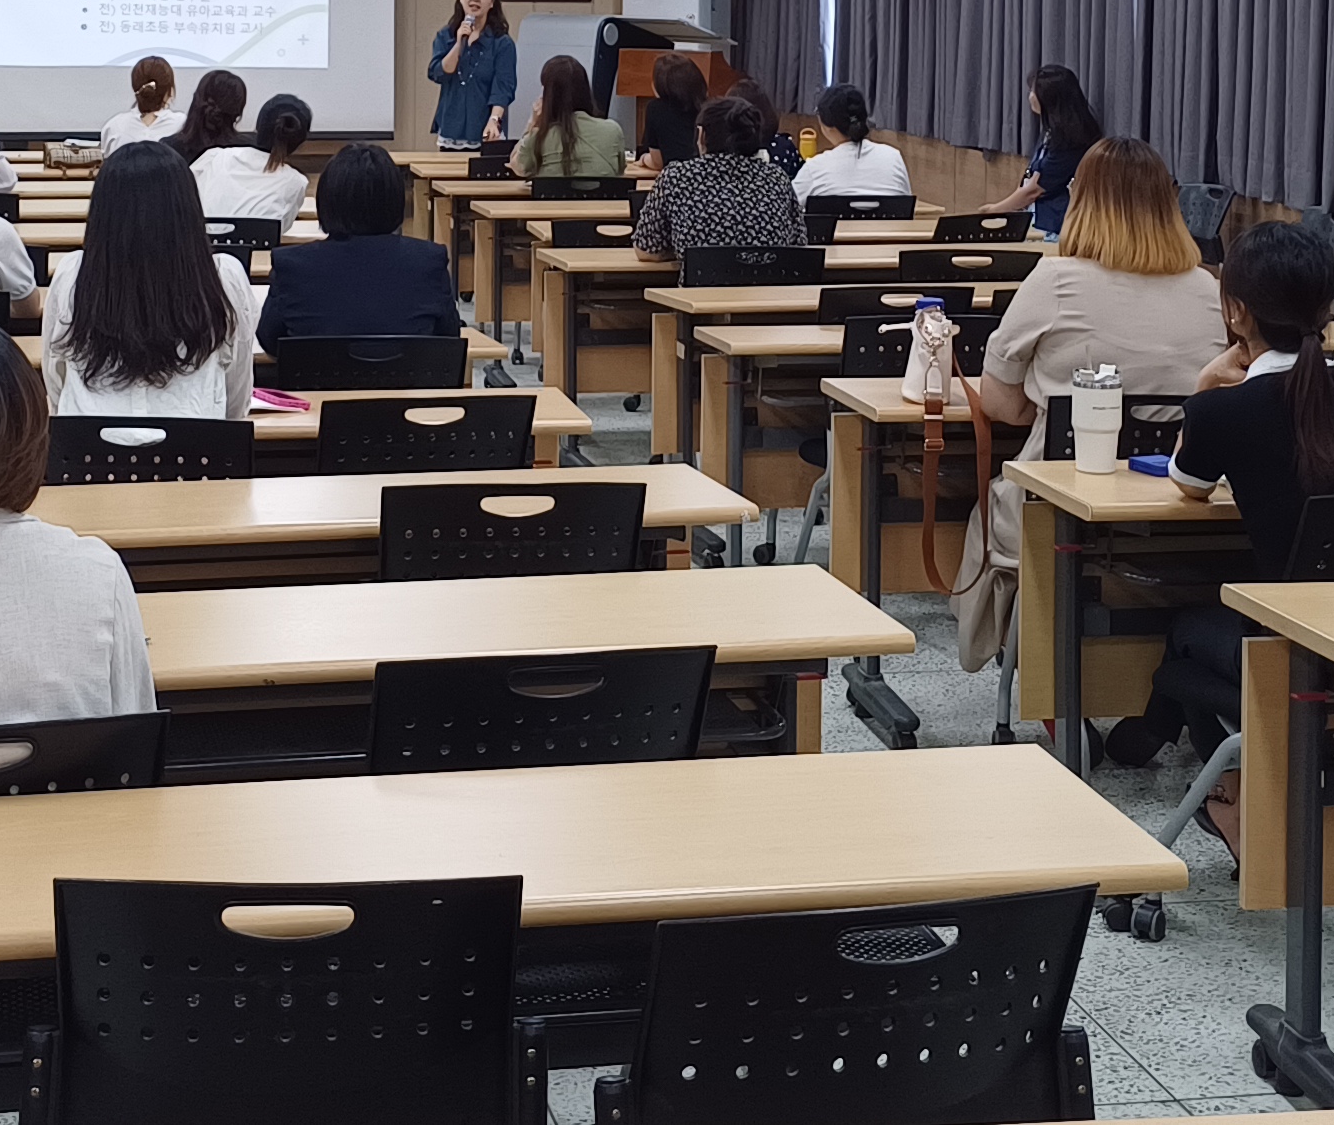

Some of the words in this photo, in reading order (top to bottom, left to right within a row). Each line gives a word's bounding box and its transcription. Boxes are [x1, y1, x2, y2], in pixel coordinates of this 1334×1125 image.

[119, 2, 182, 17] 인천재능대
[186, 4, 248, 18] 유아교육과
[251, 5, 277, 19] 교수
[240, 22, 264, 36] 교사
